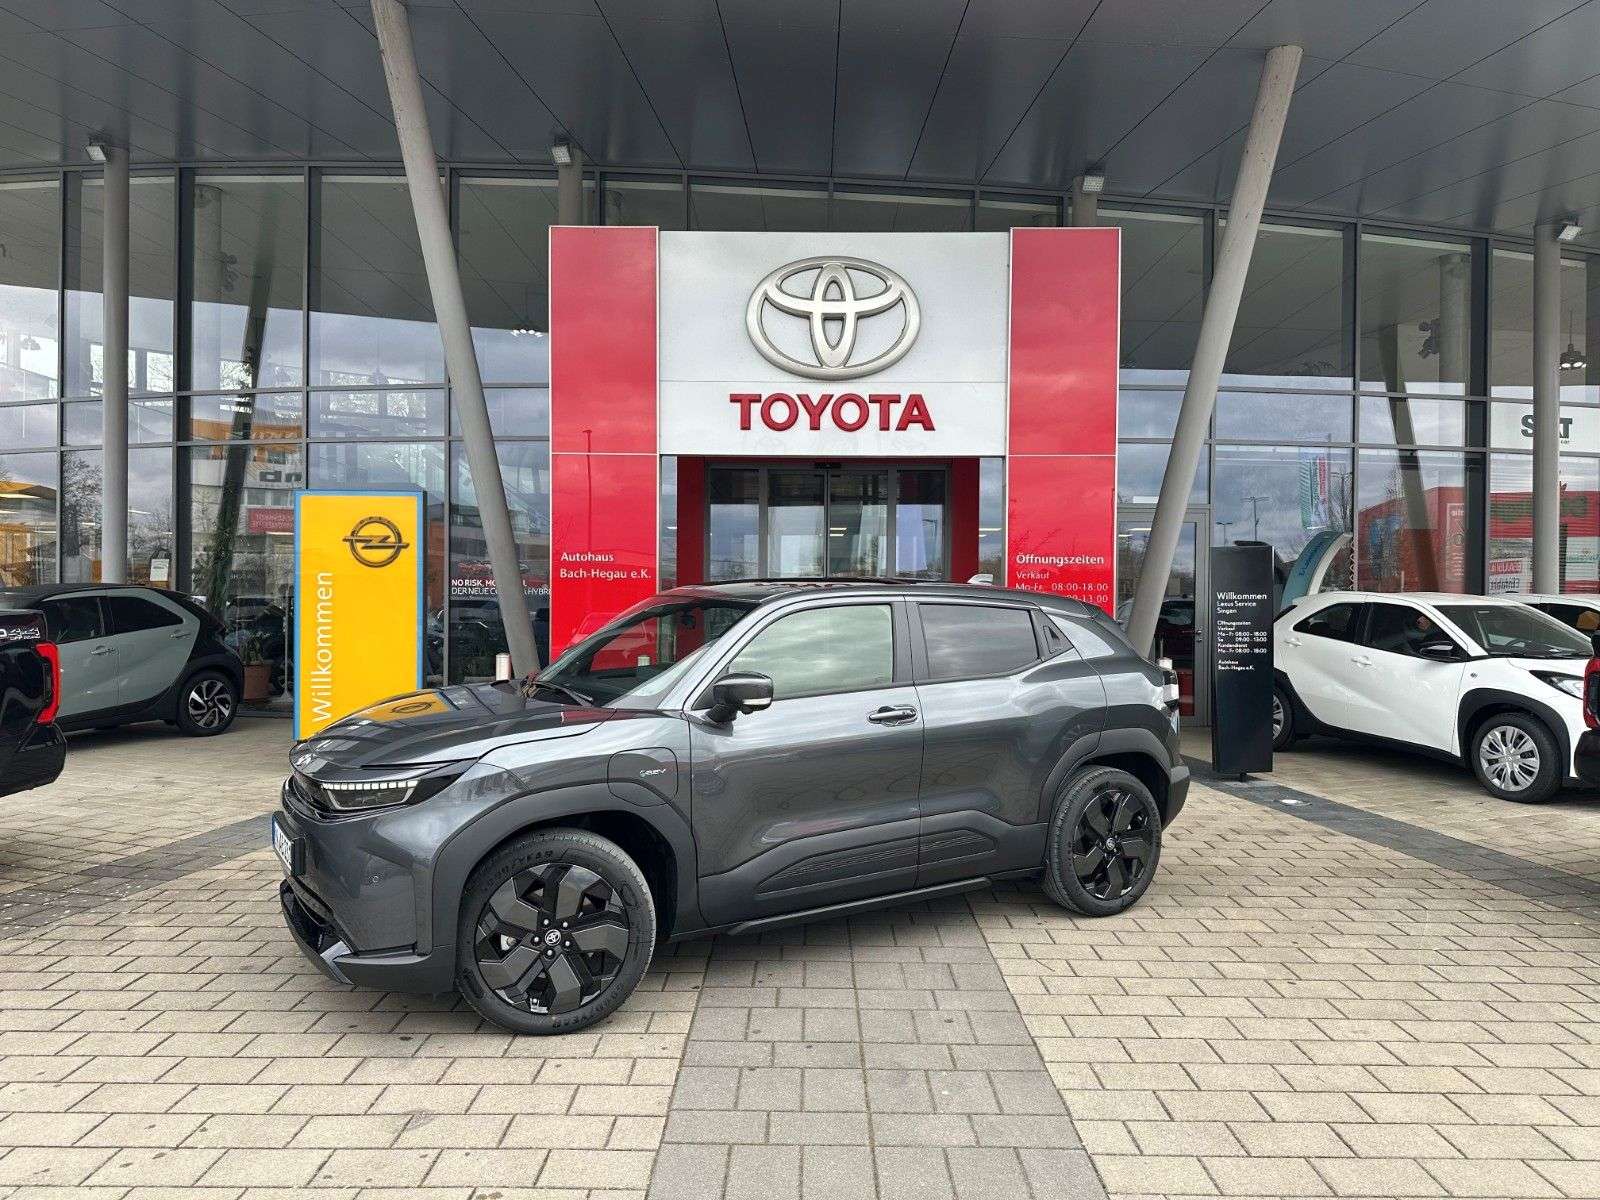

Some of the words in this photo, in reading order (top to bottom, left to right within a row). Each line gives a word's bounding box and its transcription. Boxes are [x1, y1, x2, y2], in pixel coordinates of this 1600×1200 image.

[729, 392, 936, 432] TOYOTA
[560, 551, 615, 562] Autohaus
[1016, 552, 1105, 567] Öffnungszeiten
[560, 567, 627, 581] Bach-Hegau
[630, 568, 652, 579] e.K.
[1015, 570, 1050, 580] Verkauf
[451, 579, 464, 587] NO
[451, 587, 467, 595] DER
[1216, 591, 1268, 600] Willkommen
[311, 571, 334, 723] Willkommen
